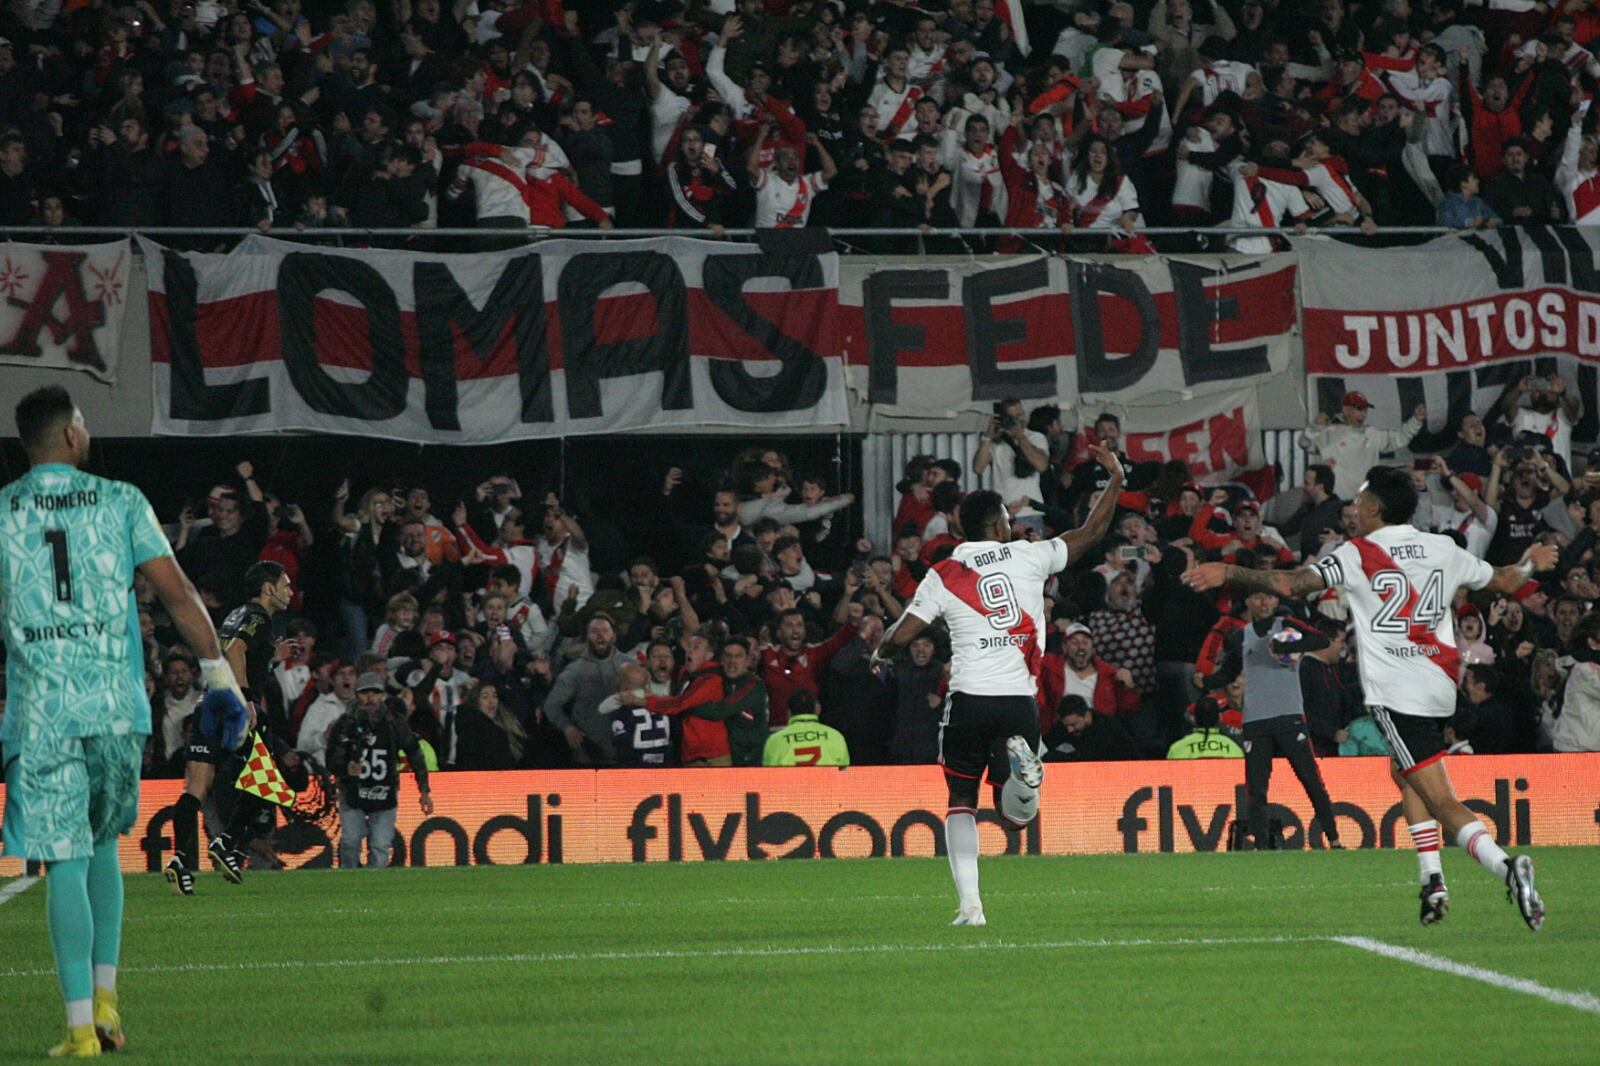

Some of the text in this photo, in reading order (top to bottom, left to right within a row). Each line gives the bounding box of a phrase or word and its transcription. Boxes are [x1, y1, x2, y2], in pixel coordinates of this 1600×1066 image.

[161, 249, 828, 431] LOMAS
[862, 257, 1271, 405] FEDE
[1334, 292, 1567, 369] JUNTOS
[10, 490, 98, 511] S. ROMERO
[974, 546, 1012, 568] BORJA
[1389, 544, 1428, 560] PEREZ
[43, 529, 73, 602] 1
[977, 571, 1022, 631] 9
[1371, 569, 1446, 634] 24
[23, 622, 106, 643] DIRECTV
[784, 730, 829, 744] TECH
[1187, 740, 1230, 754] TECH
[190, 745, 210, 754] TCL
